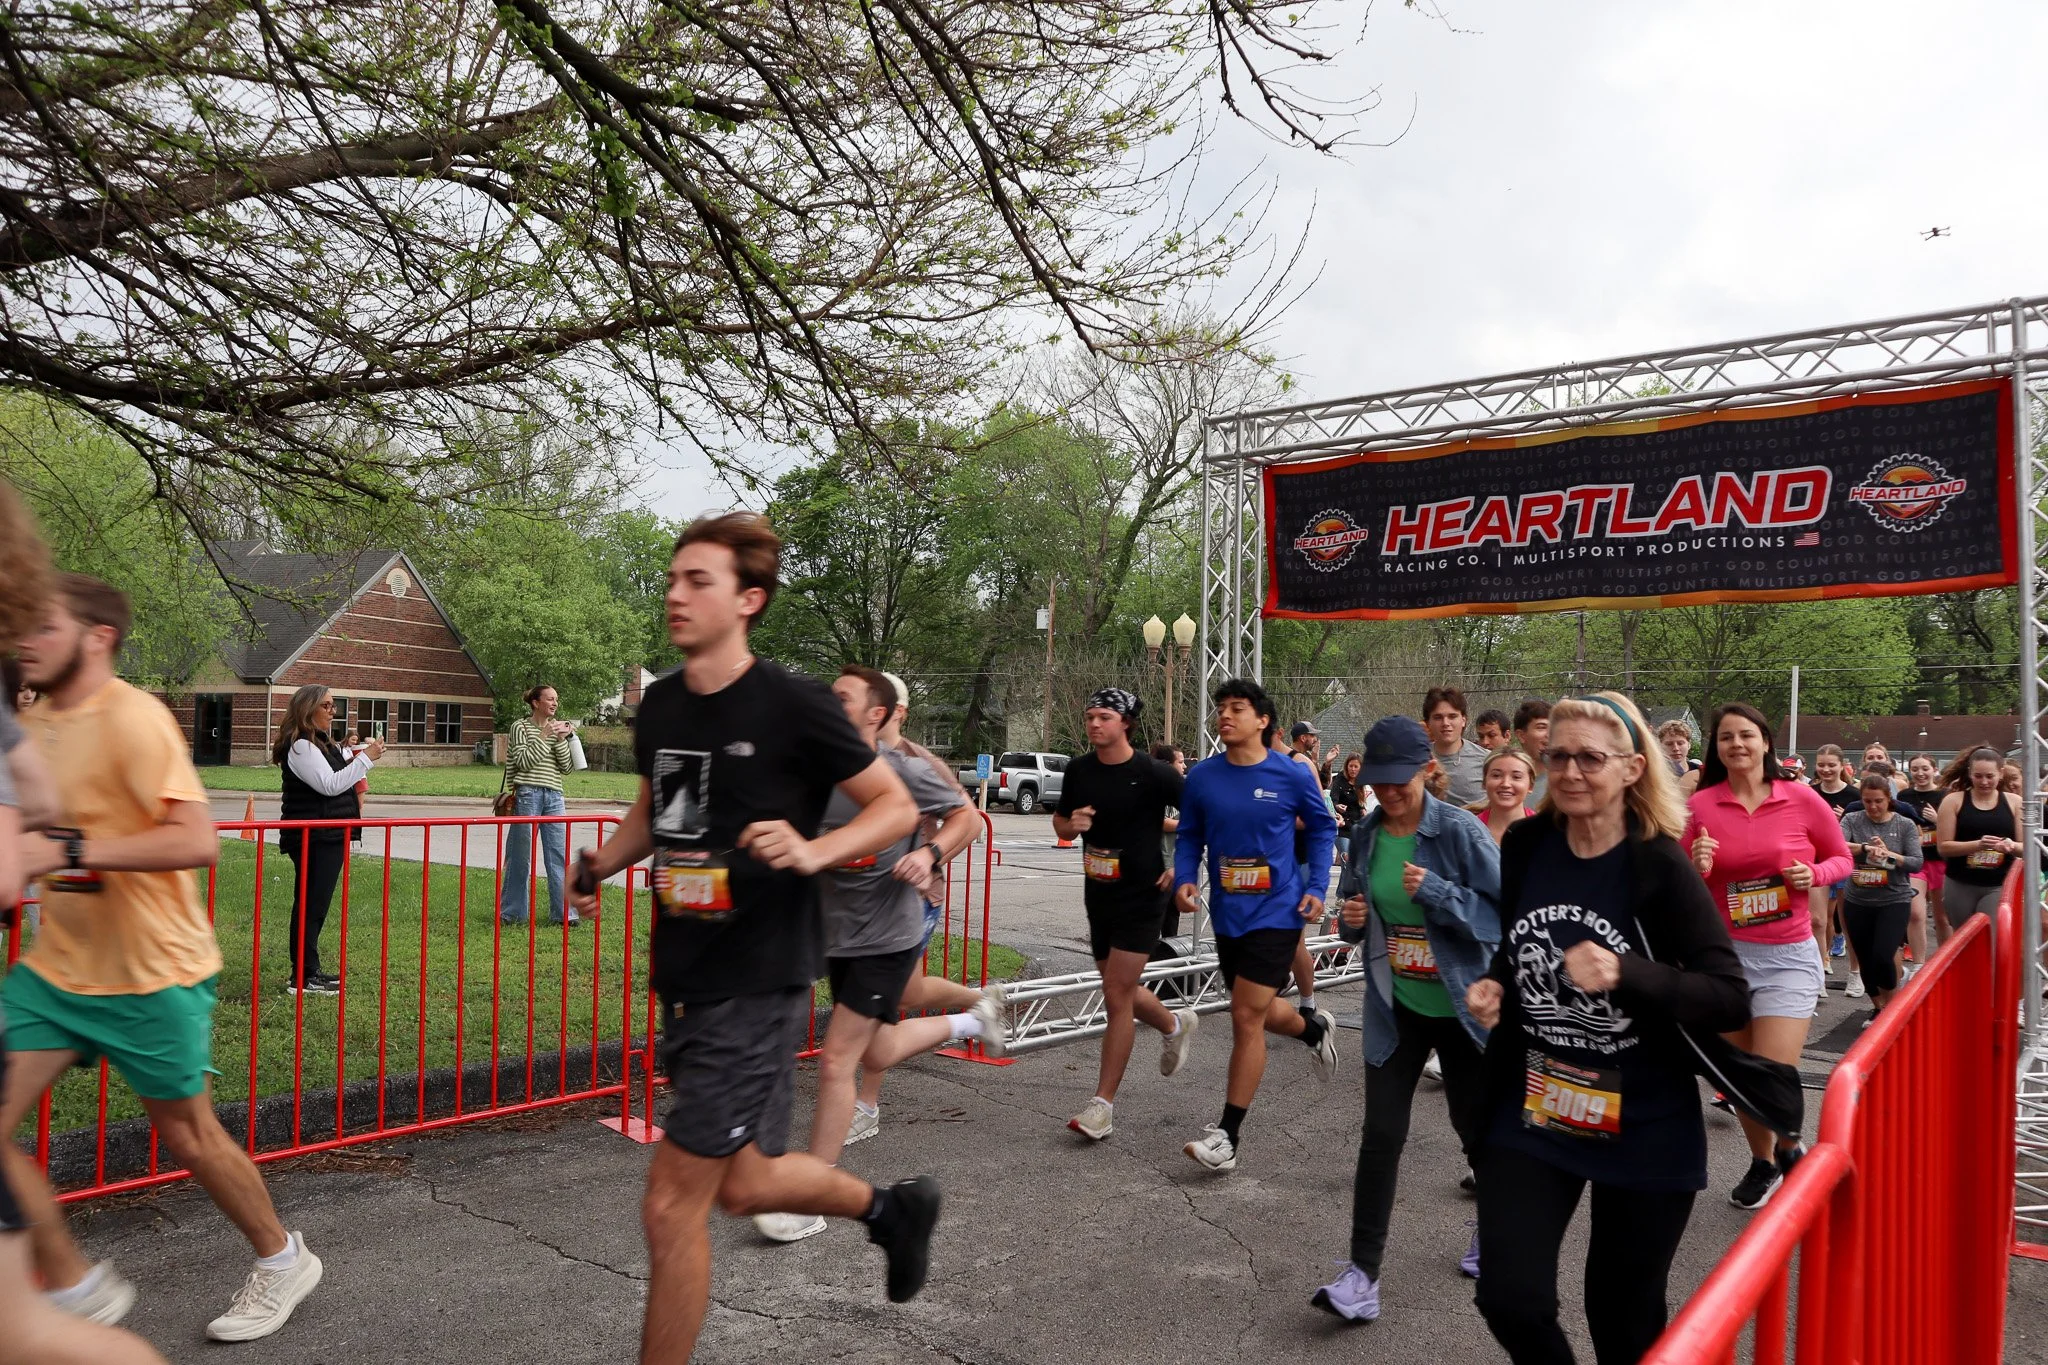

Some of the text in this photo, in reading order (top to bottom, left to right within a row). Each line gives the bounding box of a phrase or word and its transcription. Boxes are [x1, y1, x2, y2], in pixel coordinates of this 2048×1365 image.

[1852, 480, 1965, 500] HEARTLAND
[1380, 465, 1834, 556] HEARTLAND
[1295, 530, 1367, 549] HEARTLAND
[1384, 559, 1448, 573] RACING
[1457, 554, 1487, 566] CO.
[1513, 545, 1626, 566] MULTISPORT
[1636, 535, 1786, 556] PRODUCTIONS
[1232, 869, 1260, 887] 2117
[1742, 891, 1779, 916] 2138
[1583, 909, 1632, 955] HOUS
[1395, 942, 1437, 969] 2242
[1541, 1081, 1608, 1125] 2009
